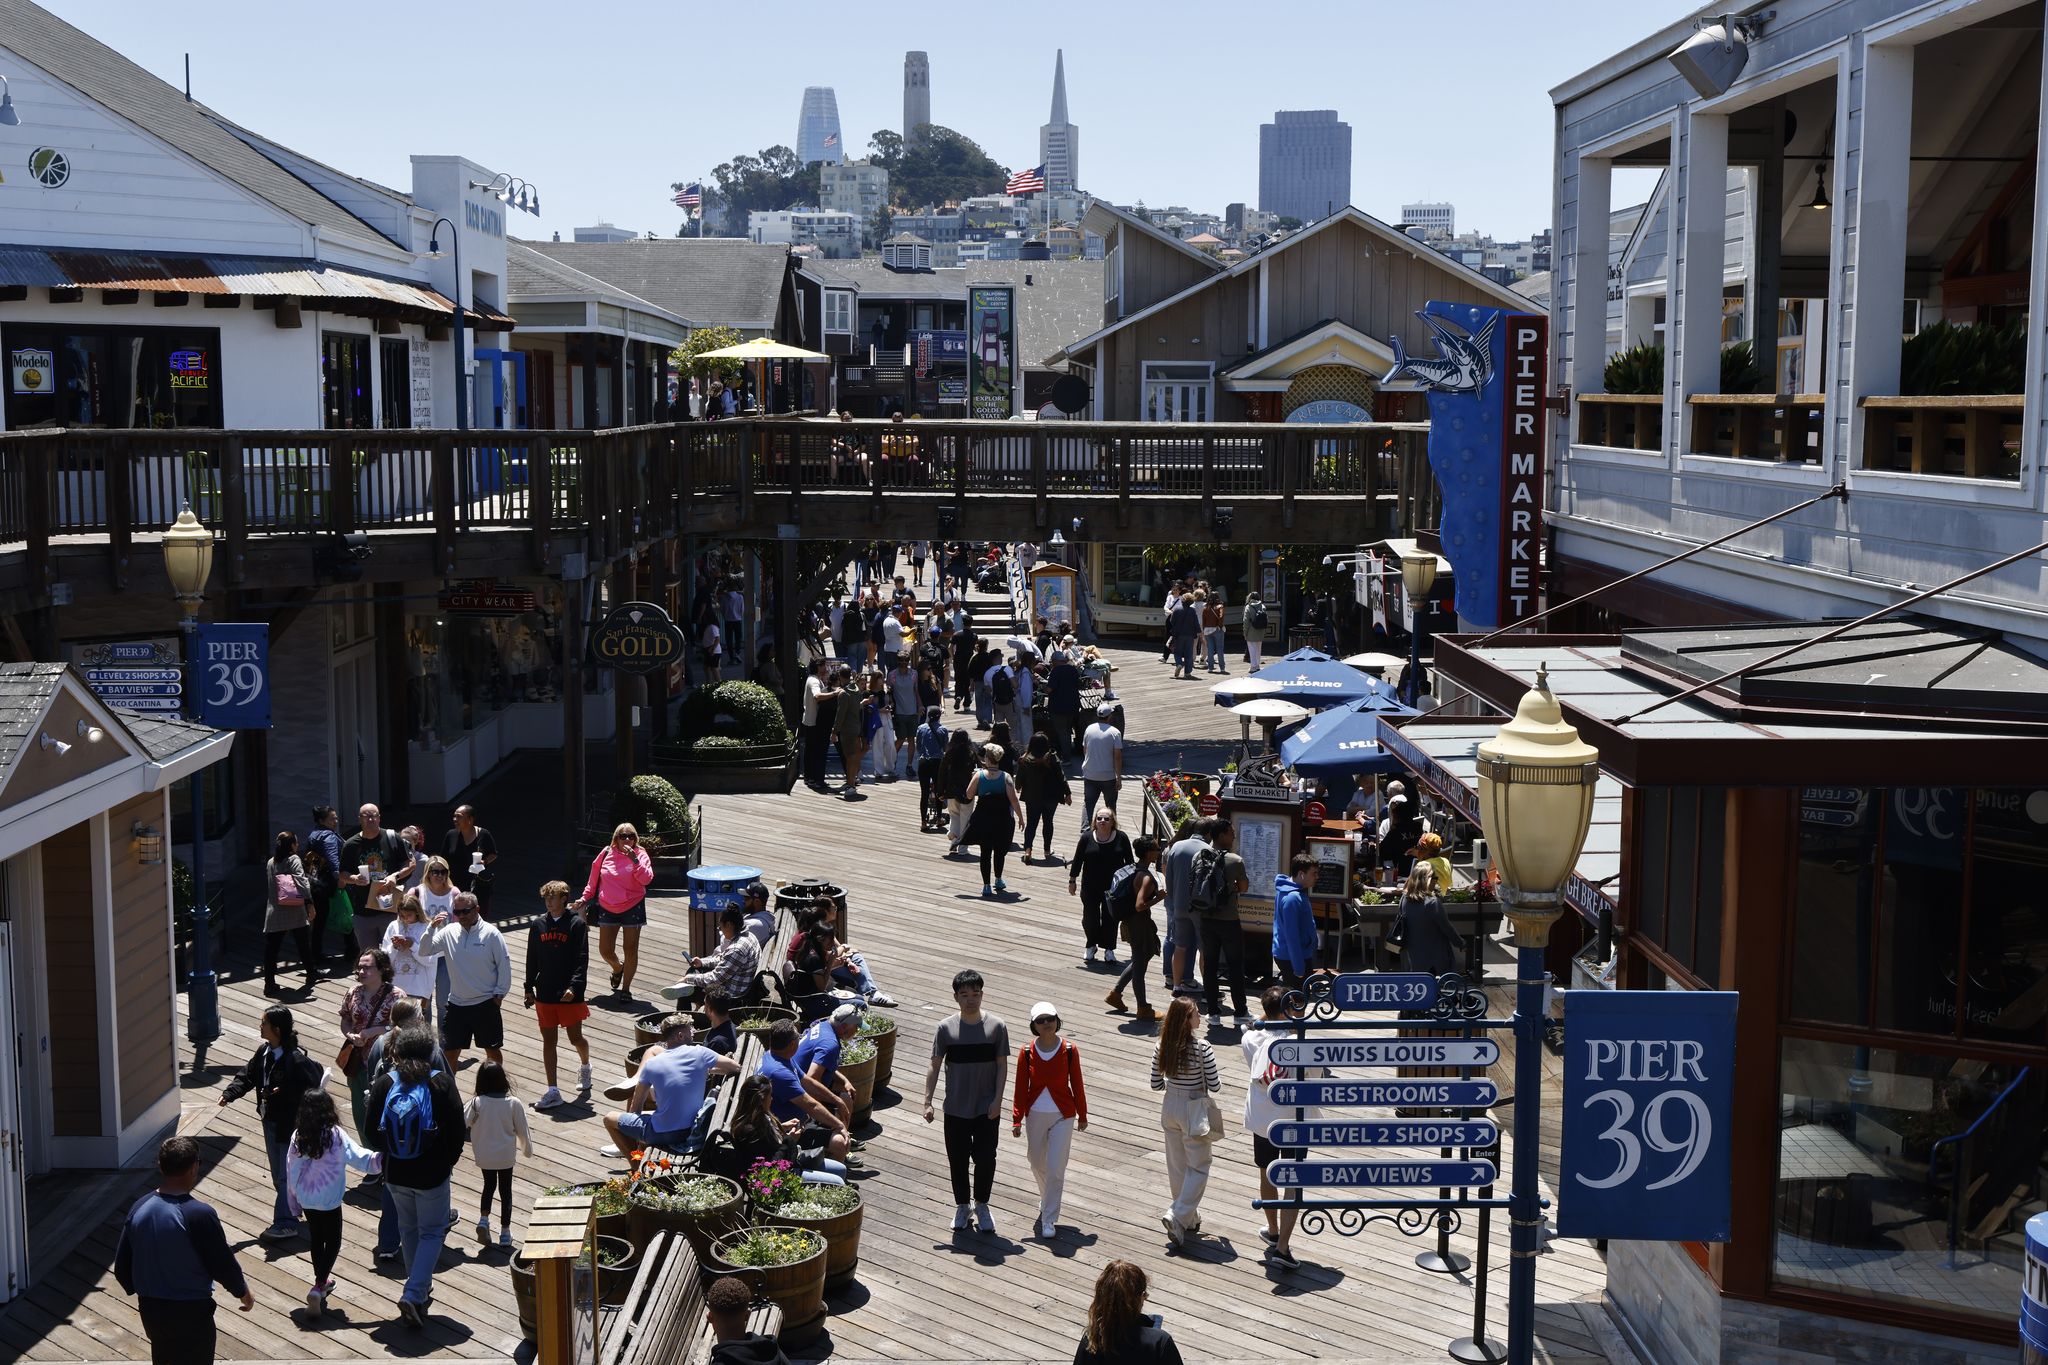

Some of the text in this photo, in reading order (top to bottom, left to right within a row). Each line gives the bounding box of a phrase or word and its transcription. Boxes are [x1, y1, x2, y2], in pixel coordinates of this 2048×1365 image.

[465, 200, 480, 231] TACO
[13, 354, 49, 368] Modelo
[1510, 328, 1538, 616] PIER MARKET
[451, 598, 515, 607] CITY WEAR
[606, 625, 668, 639] San Francisco
[116, 647, 150, 657] PIER 39
[207, 642, 260, 661] PIER
[601, 636, 673, 657] GOLD
[99, 672, 160, 680] LEVEL 2 SHOPS
[207, 663, 263, 706] 39
[108, 686, 154, 694] BAY VIEWS
[128, 700, 162, 708] CANTINA
[1236, 786, 1287, 798] PIER MARKET
[1430, 762, 1442, 786] FISH
[1447, 775, 1464, 806] CHIPS
[1346, 983, 1427, 1002] PIER 39
[1313, 1045, 1446, 1062] SWISS LOUIS
[1585, 1039, 1709, 1082] PIER
[1321, 1086, 1449, 1103] RESTROOMS
[1309, 1126, 1466, 1143] LEVEL 2 SHOPS
[1575, 1089, 1713, 1190] 39
[1475, 1150, 1496, 1158] Enter
[1322, 1167, 1432, 1183] BAY VIEWS
